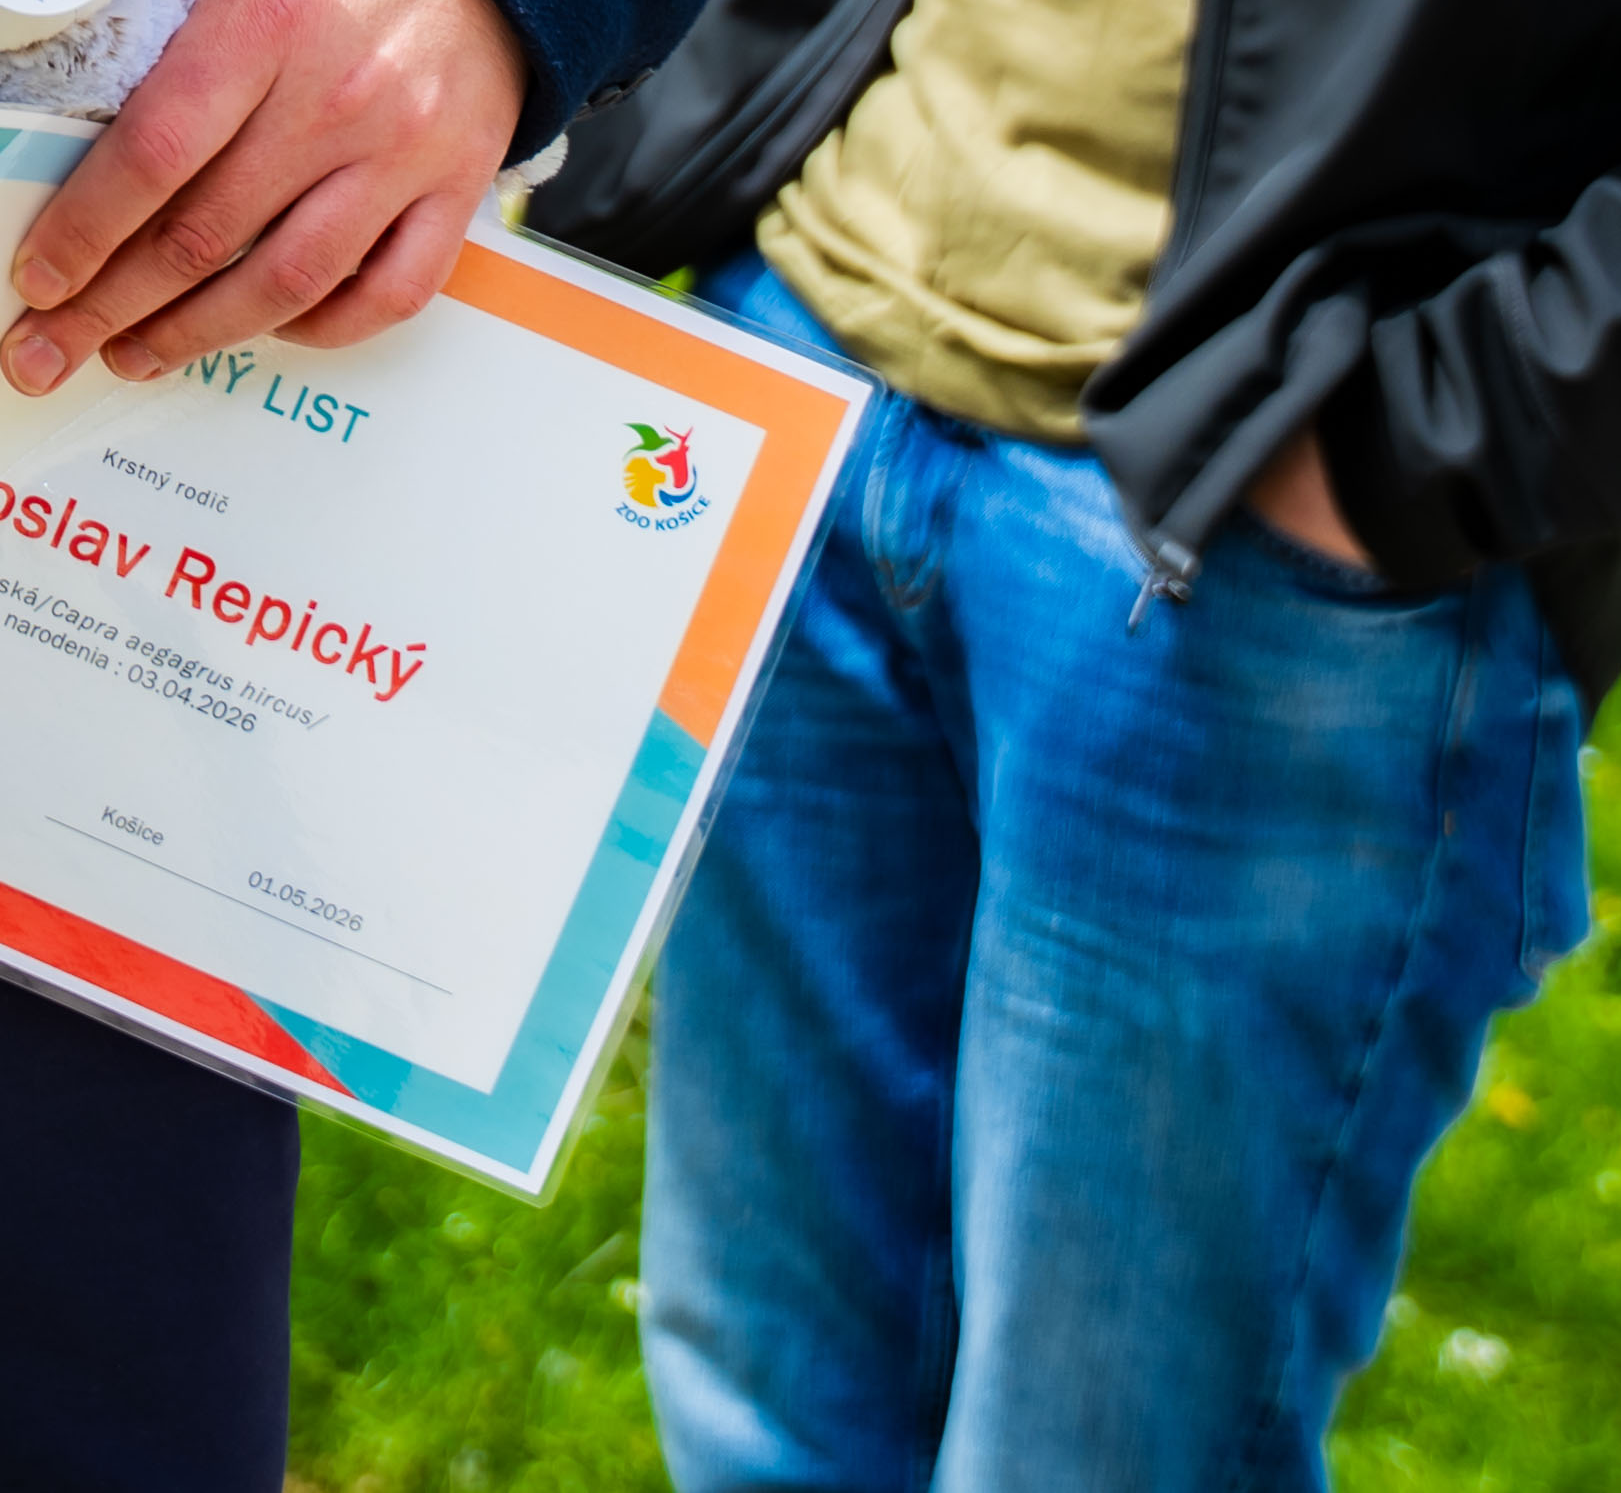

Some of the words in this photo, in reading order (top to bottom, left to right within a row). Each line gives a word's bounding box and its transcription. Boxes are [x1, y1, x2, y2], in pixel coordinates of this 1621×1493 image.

[262, 373, 370, 444] LIST
[102, 447, 172, 491] Krstný
[174, 481, 231, 514] rodič
[615, 501, 651, 529] ZOO
[654, 494, 711, 532] KOŠICE
[164, 546, 428, 703] Repický
[3, 612, 110, 671] narodenia
[127, 664, 258, 733] 03.04.2026
[124, 634, 235, 692] aegagrus
[239, 681, 330, 730] hircus/
[100, 805, 165, 846] Košice
[247, 870, 364, 933] 01.05.2026
